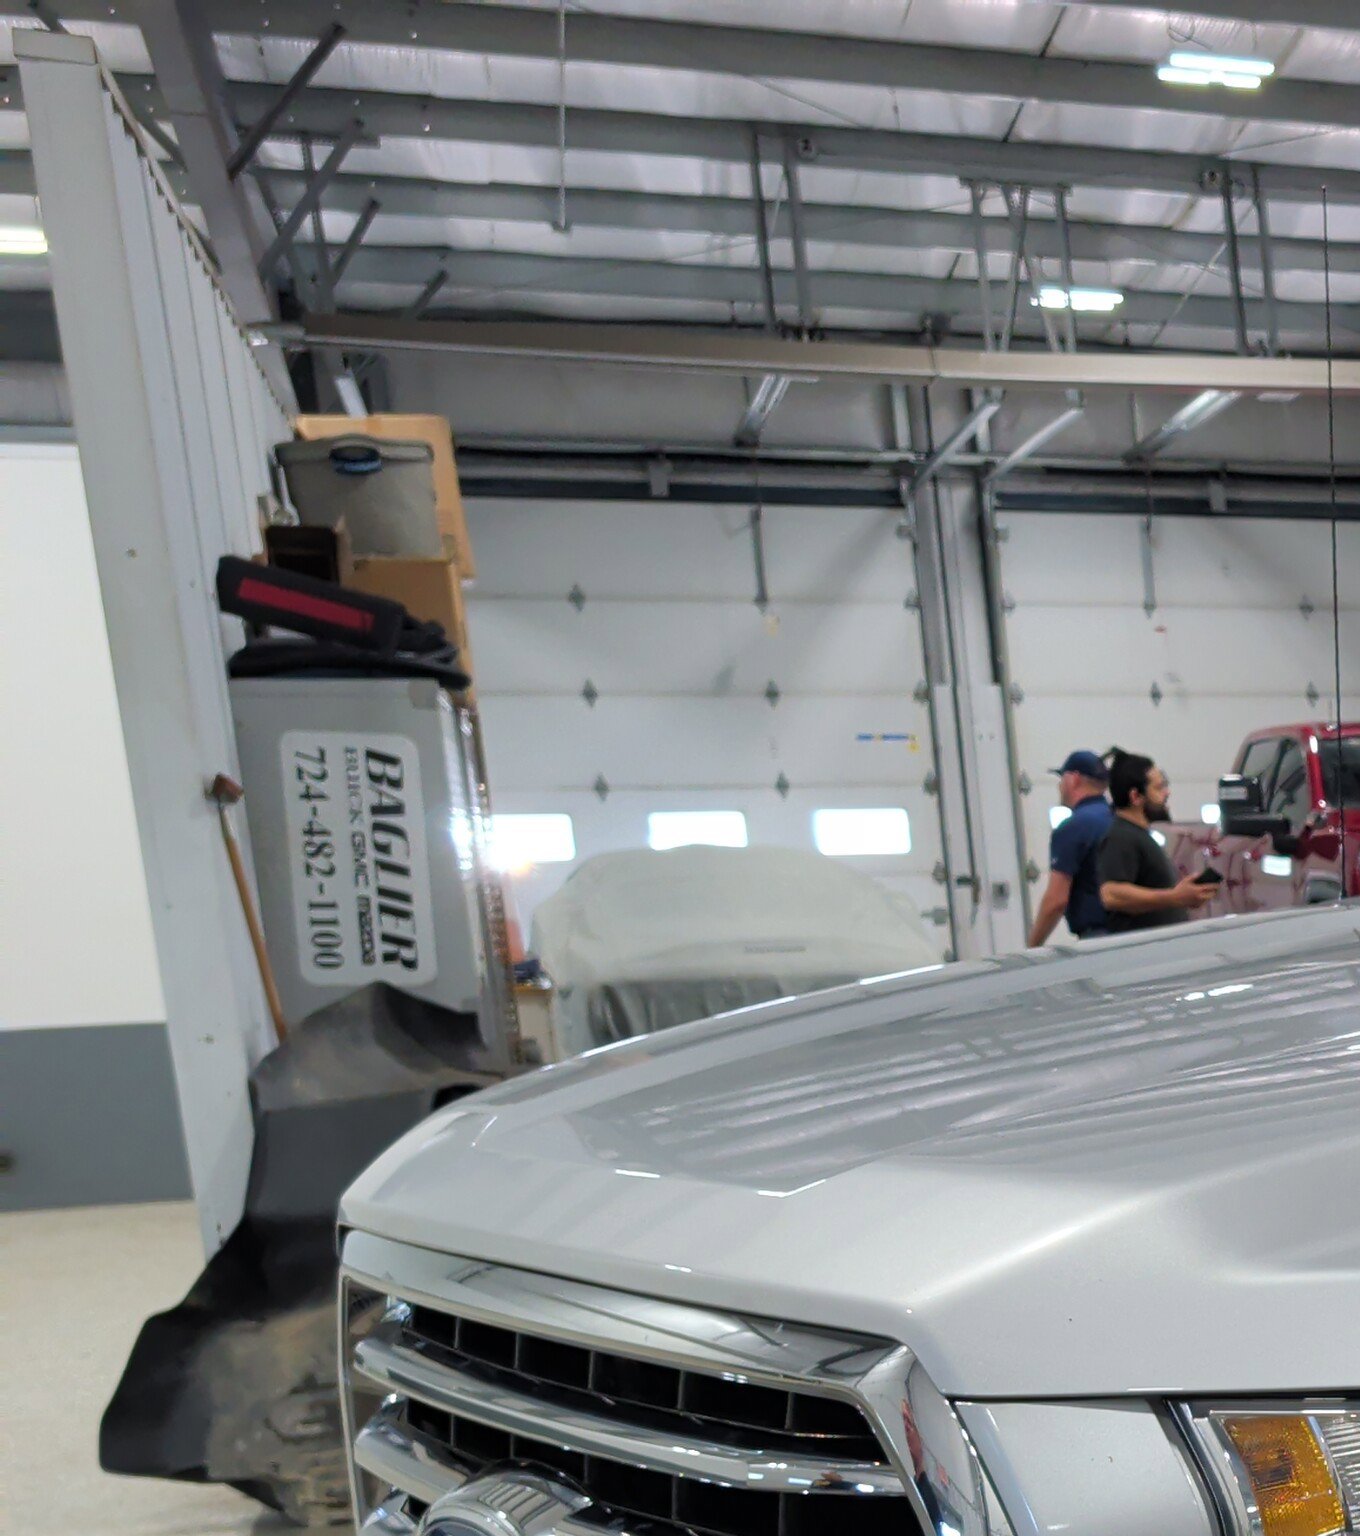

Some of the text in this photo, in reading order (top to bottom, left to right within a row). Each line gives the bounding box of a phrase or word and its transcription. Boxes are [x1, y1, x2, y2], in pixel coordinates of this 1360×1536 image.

[294, 746, 345, 970] 724-482-1100
[351, 831, 370, 888] GMC
[356, 894, 376, 966] mazda
[365, 747, 418, 970] BAGLIER
